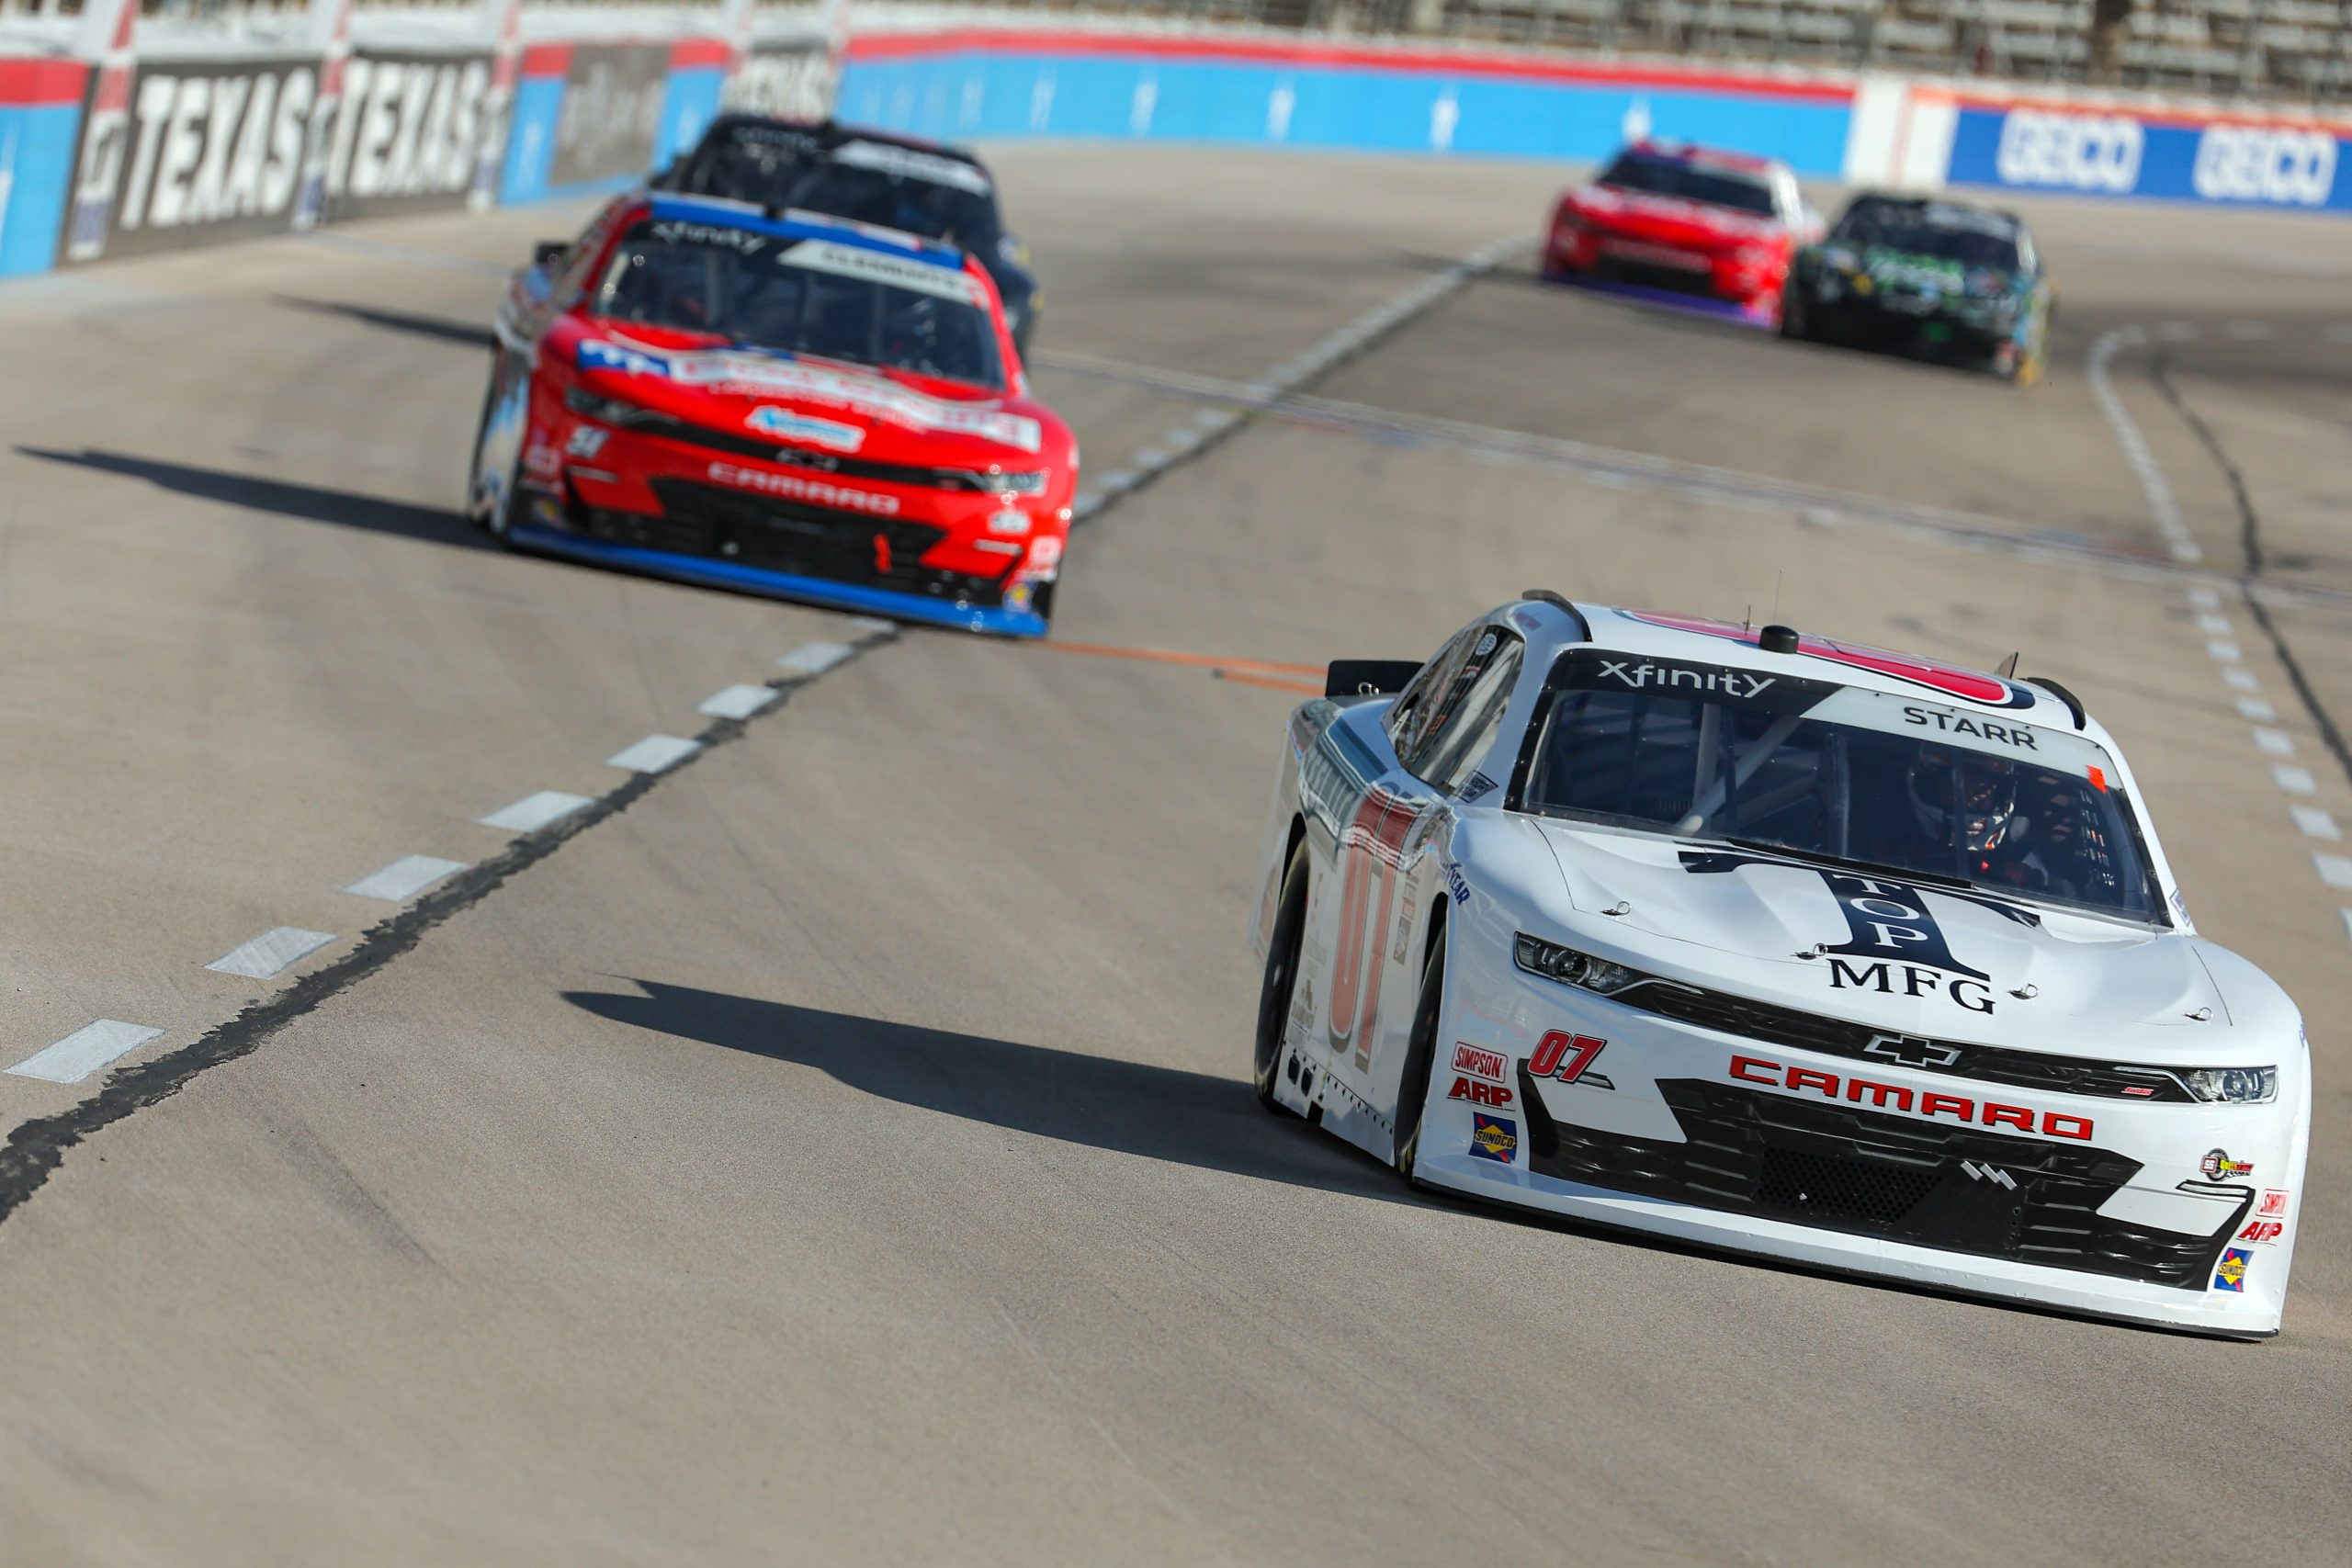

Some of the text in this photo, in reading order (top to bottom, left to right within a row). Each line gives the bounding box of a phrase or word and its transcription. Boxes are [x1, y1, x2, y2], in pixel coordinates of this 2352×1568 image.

[119, 67, 315, 230] TEXAS
[326, 58, 491, 197] TEXAS
[708, 461, 900, 516] CAMARO
[1903, 706, 2039, 751] STARR
[1826, 958, 1996, 1015] MFG
[1454, 1044, 1503, 1078] SIMPSON
[1527, 1029, 1609, 1085] 07
[1446, 1077, 1514, 1107] ARP
[1728, 1055, 2095, 1142] CAMARO
[1476, 1129, 1516, 1148] SUNOCO
[2238, 1220, 2283, 1242] ARP
